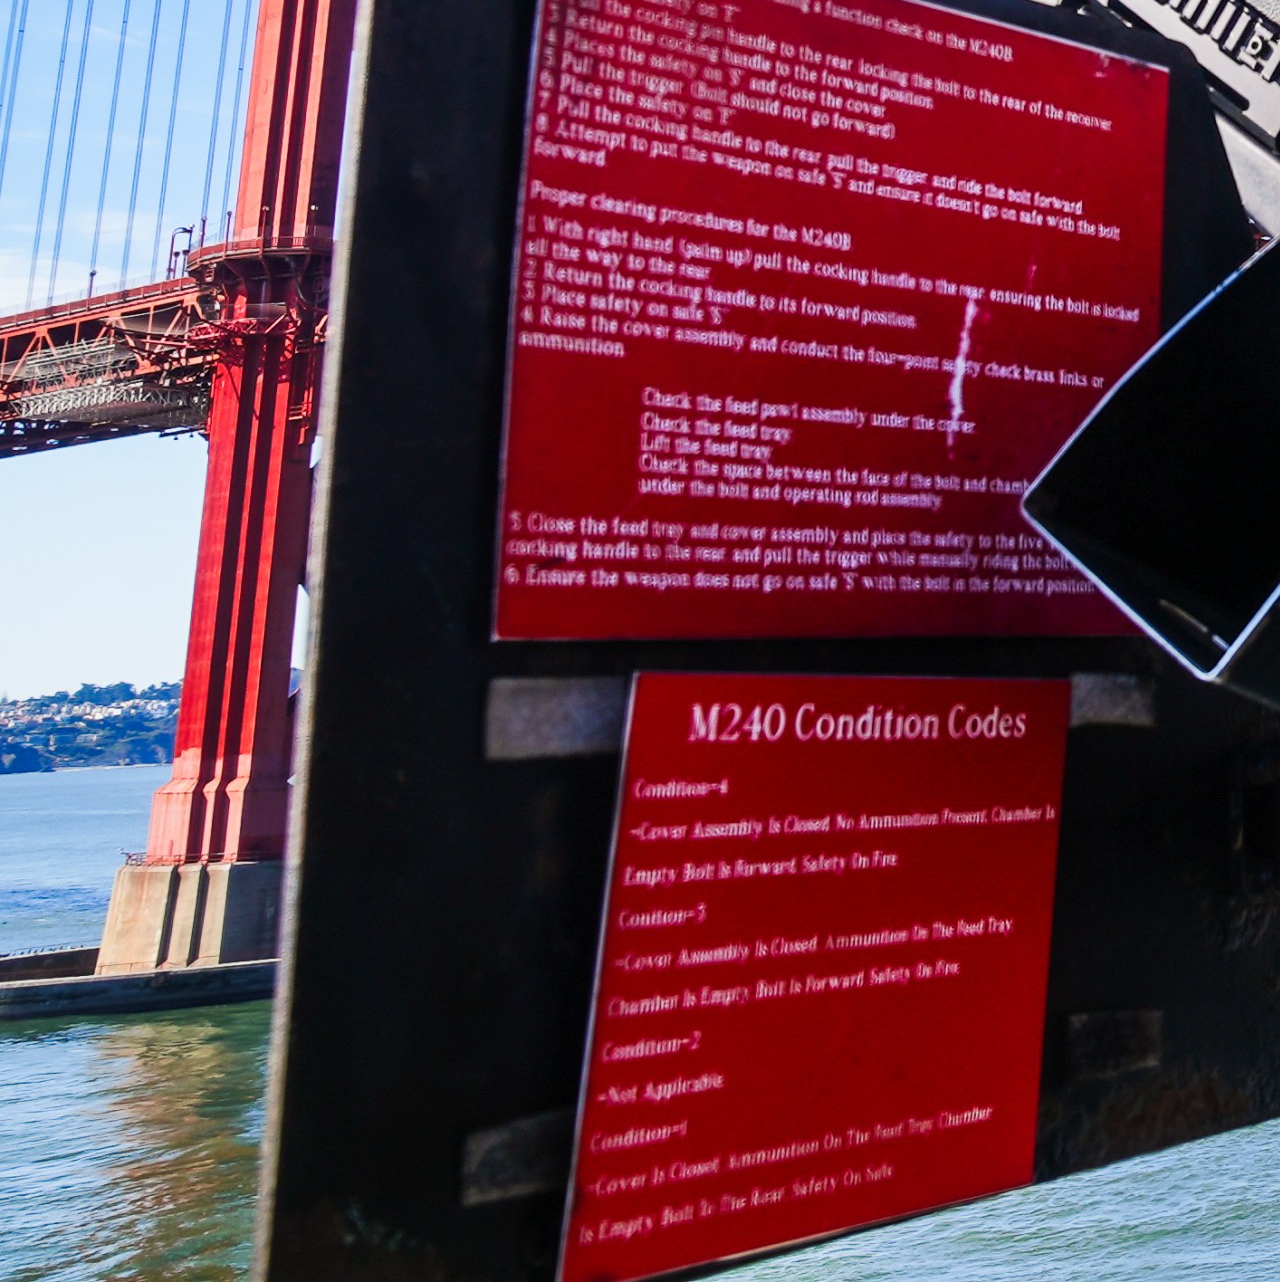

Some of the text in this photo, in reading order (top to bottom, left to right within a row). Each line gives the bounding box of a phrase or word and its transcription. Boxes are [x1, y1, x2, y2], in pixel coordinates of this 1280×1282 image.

[566, 9, 624, 37] Return
[629, 26, 655, 44] the
[659, 36, 719, 63] cocking
[723, 49, 772, 72] handle
[775, 61, 790, 77] to
[794, 65, 818, 83] the
[821, 70, 879, 96] forward
[813, 0, 822, 14] a
[825, 0, 883, 29] function
[885, 19, 924, 40] check
[925, 30, 944, 45] on
[945, 33, 967, 51] the
[561, 52, 589, 73] Pull
[599, 63, 625, 82] the
[630, 70, 683, 95] trigger
[731, 93, 780, 115] should
[782, 105, 807, 122] not
[811, 111, 830, 128] go
[557, 95, 590, 118] Pull
[595, 105, 622, 125] the
[625, 114, 688, 141] cocking
[692, 126, 743, 148] handle
[745, 136, 763, 153] to
[764, 140, 790, 158] the
[792, 147, 822, 163] rear
[826, 154, 854, 171] pull
[856, 158, 880, 175] the
[882, 164, 928, 185] trigger
[932, 175, 957, 190] and
[957, 179, 983, 195] ride
[984, 183, 1006, 200] the
[1007, 188, 1032, 205] bolt
[532, 181, 587, 207] Proper
[590, 194, 657, 222] clearing
[659, 208, 744, 233] procedures
[746, 218, 770, 237] for
[773, 224, 798, 242] the
[527, 238, 548, 256] all
[552, 243, 580, 261] the
[586, 249, 622, 270] way
[627, 254, 645, 270] to
[649, 257, 675, 274] the
[543, 216, 583, 239] With
[587, 228, 628, 248] right
[633, 232, 674, 253] hand
[753, 253, 782, 270] pull
[786, 256, 811, 274] the
[814, 263, 869, 286] cocking
[871, 269, 917, 289] handle
[918, 277, 934, 292] to
[935, 279, 958, 295] the
[959, 284, 985, 300] rear
[989, 289, 1042, 311] ensuring
[1044, 295, 1065, 311] the
[1066, 297, 1090, 315] bolt
[1090, 303, 1102, 317] is
[1102, 304, 1140, 322] locked
[544, 262, 603, 286] Return
[608, 272, 635, 291] the
[640, 280, 702, 305] cocking
[705, 287, 757, 308] handle
[759, 294, 776, 311] to
[778, 297, 798, 313] its
[801, 298, 860, 321] forward
[640, 433, 671, 451] Lift
[675, 438, 700, 454] the
[705, 439, 738, 457] feed
[641, 412, 690, 433] Check
[695, 419, 721, 436] the
[724, 420, 757, 439] feed
[689, 703, 1026, 741] M240 Condition Codes
